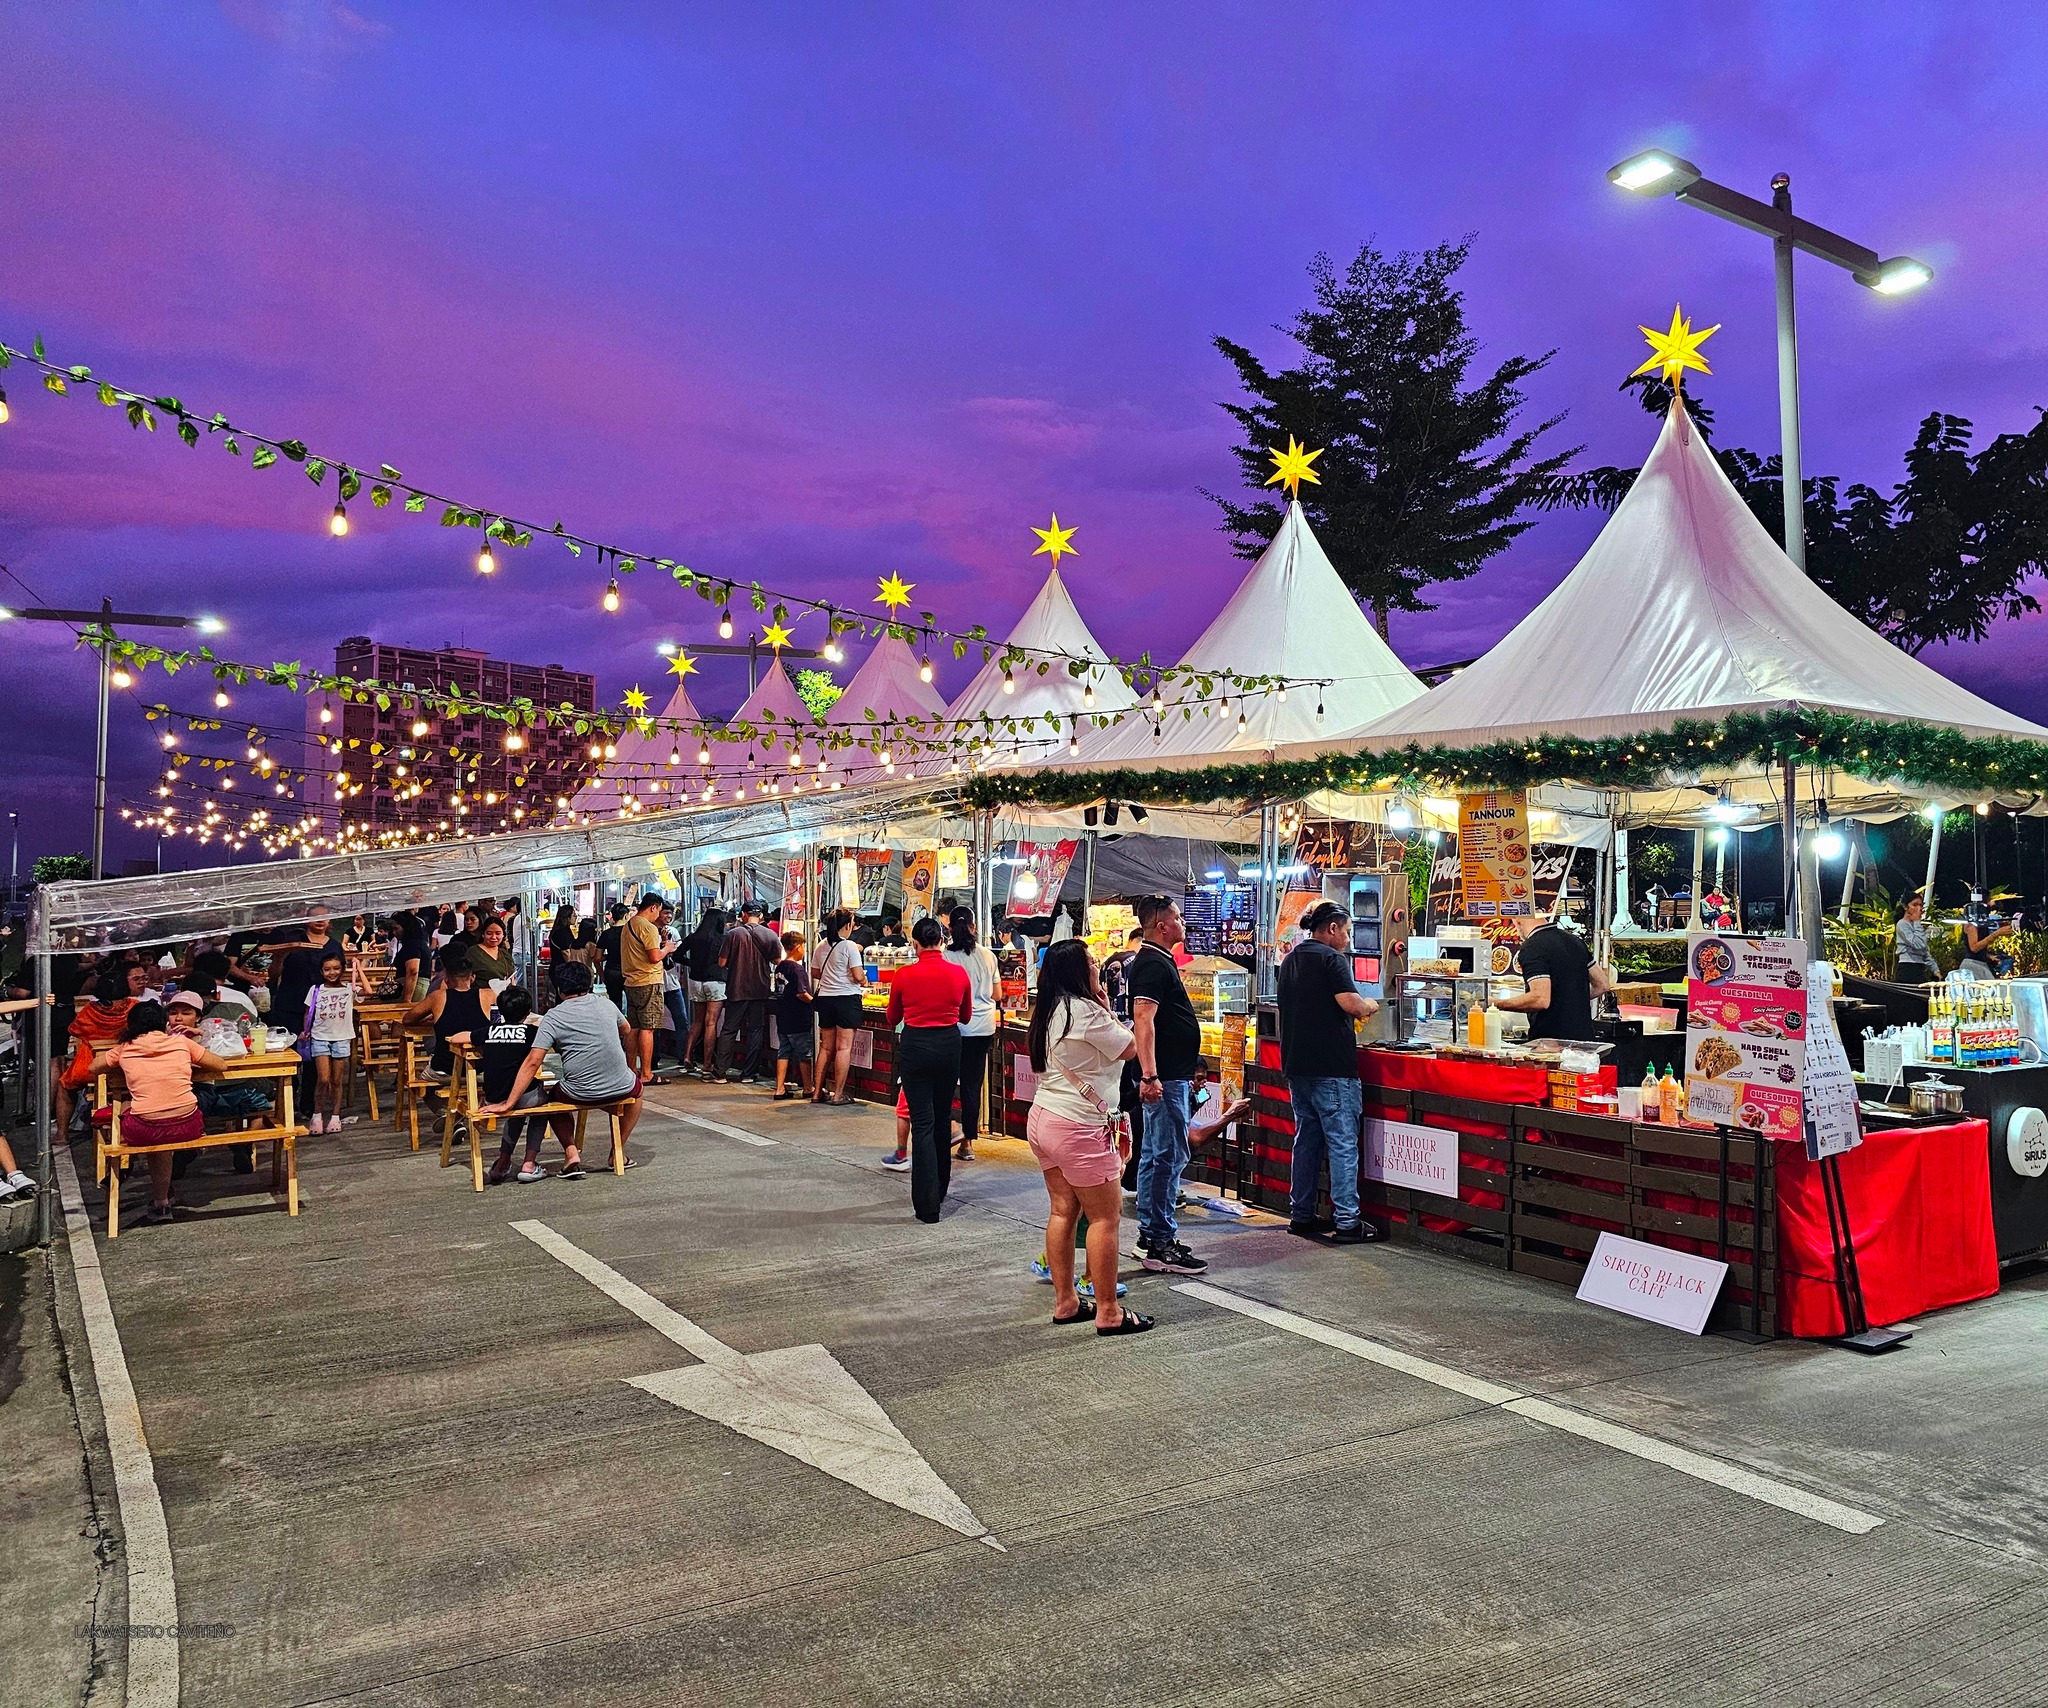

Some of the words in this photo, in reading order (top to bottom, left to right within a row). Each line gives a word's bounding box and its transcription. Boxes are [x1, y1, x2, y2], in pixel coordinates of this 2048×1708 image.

[1468, 808, 1516, 820] TANNOUR
[1742, 954, 1764, 962] SOFT
[1764, 956, 1793, 965] BIRRIA
[1786, 974, 1799, 982] 150
[1721, 988, 1773, 1000] QUESADILLA
[488, 1024, 528, 1040] VANS
[1741, 1043, 1762, 1052] HARD
[1763, 1046, 1790, 1056] SHELL
[1752, 1052, 1779, 1061] TACOS
[1781, 1067, 1793, 1076] 150
[1704, 1087, 1721, 1100] NOT
[1750, 1090, 1799, 1104] QUESORITO
[1690, 1096, 1731, 1115] AVAILABLE
[1383, 1131, 1437, 1152] TANNOUR
[1389, 1145, 1432, 1164] ARABIC
[2024, 1149, 2047, 1162] SIRIUS
[1374, 1154, 1447, 1180] RESTAURANT
[1601, 1254, 1652, 1279] SIRIUS
[1655, 1269, 1707, 1294] BLACK
[1628, 1277, 1668, 1299] CAFE
